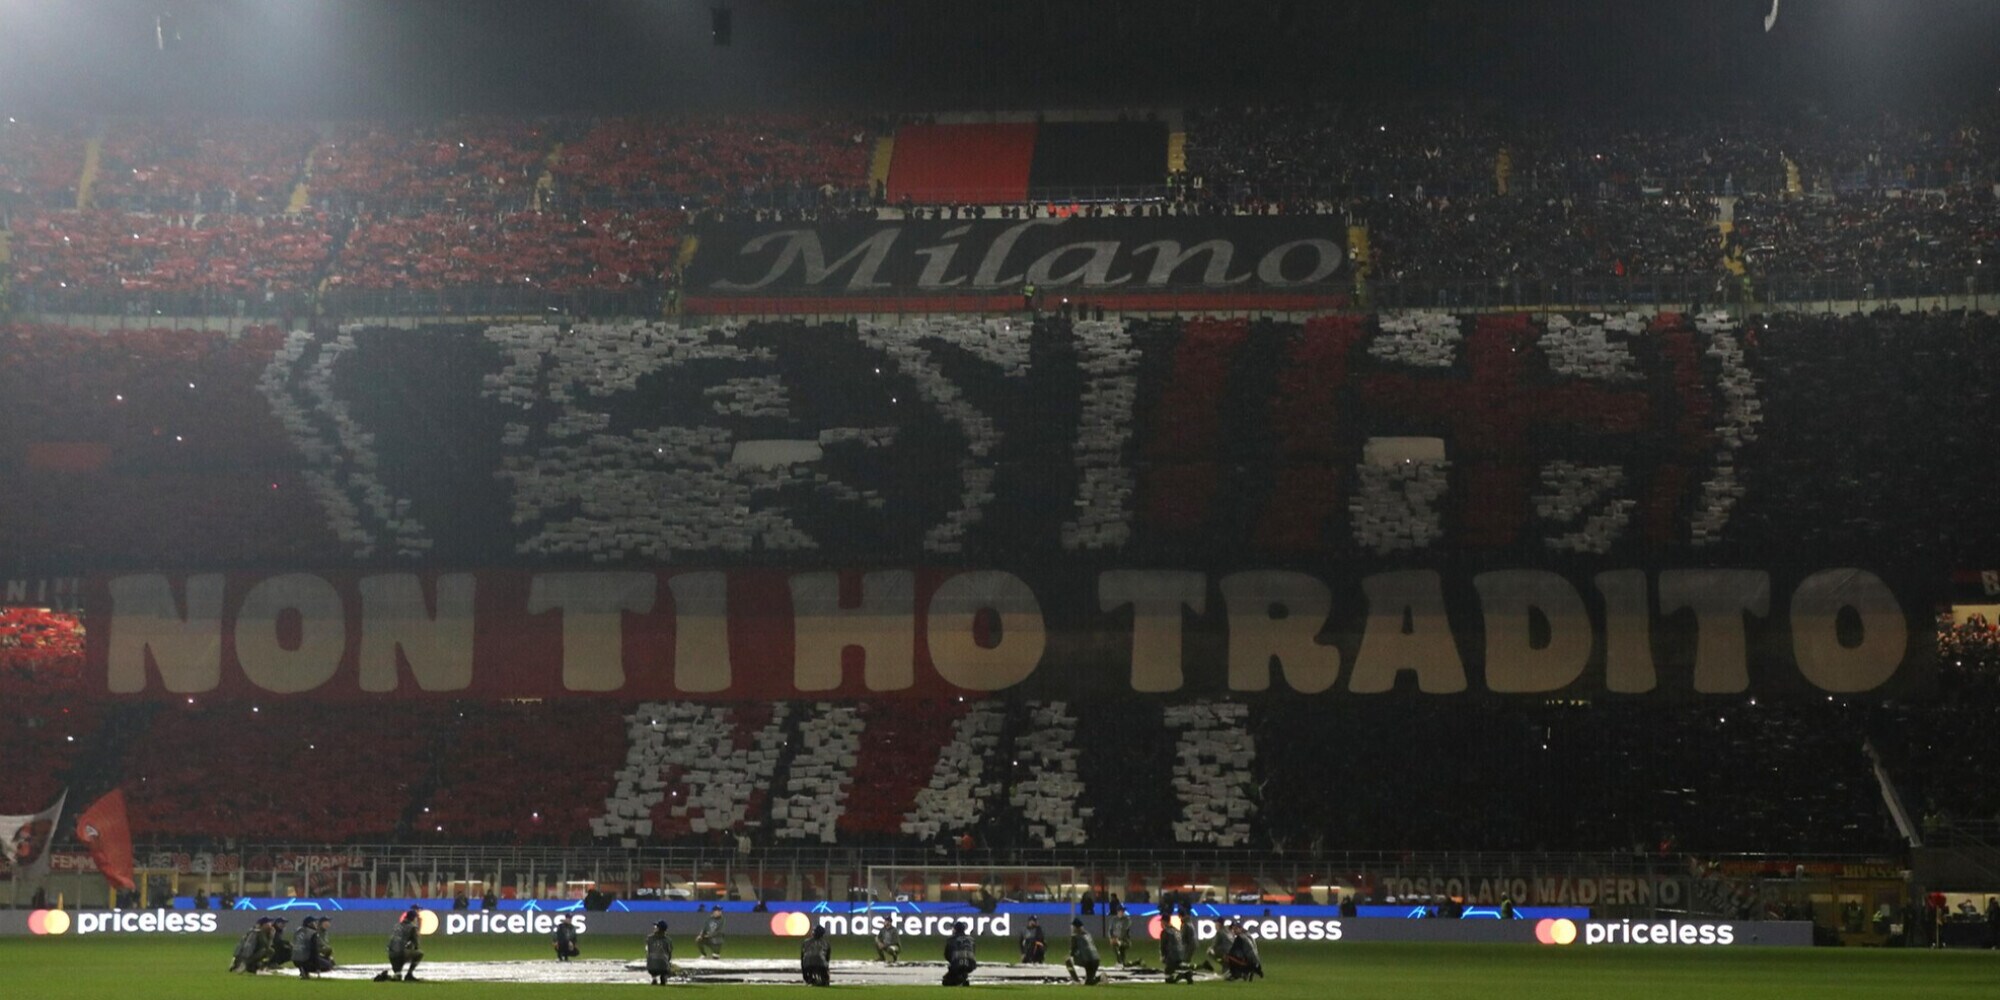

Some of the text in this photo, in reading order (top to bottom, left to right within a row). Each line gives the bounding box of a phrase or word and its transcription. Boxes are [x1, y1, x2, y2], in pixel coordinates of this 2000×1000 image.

[709, 217, 1342, 290] Milano
[107, 568, 1908, 695] NON TI HO TRADITO
[1535, 878, 1680, 905] MADERNO
[77, 908, 218, 934] priceless
[819, 911, 1010, 937] mastercard
[1197, 914, 1343, 941] pceless
[1585, 918, 1734, 945] priceless
